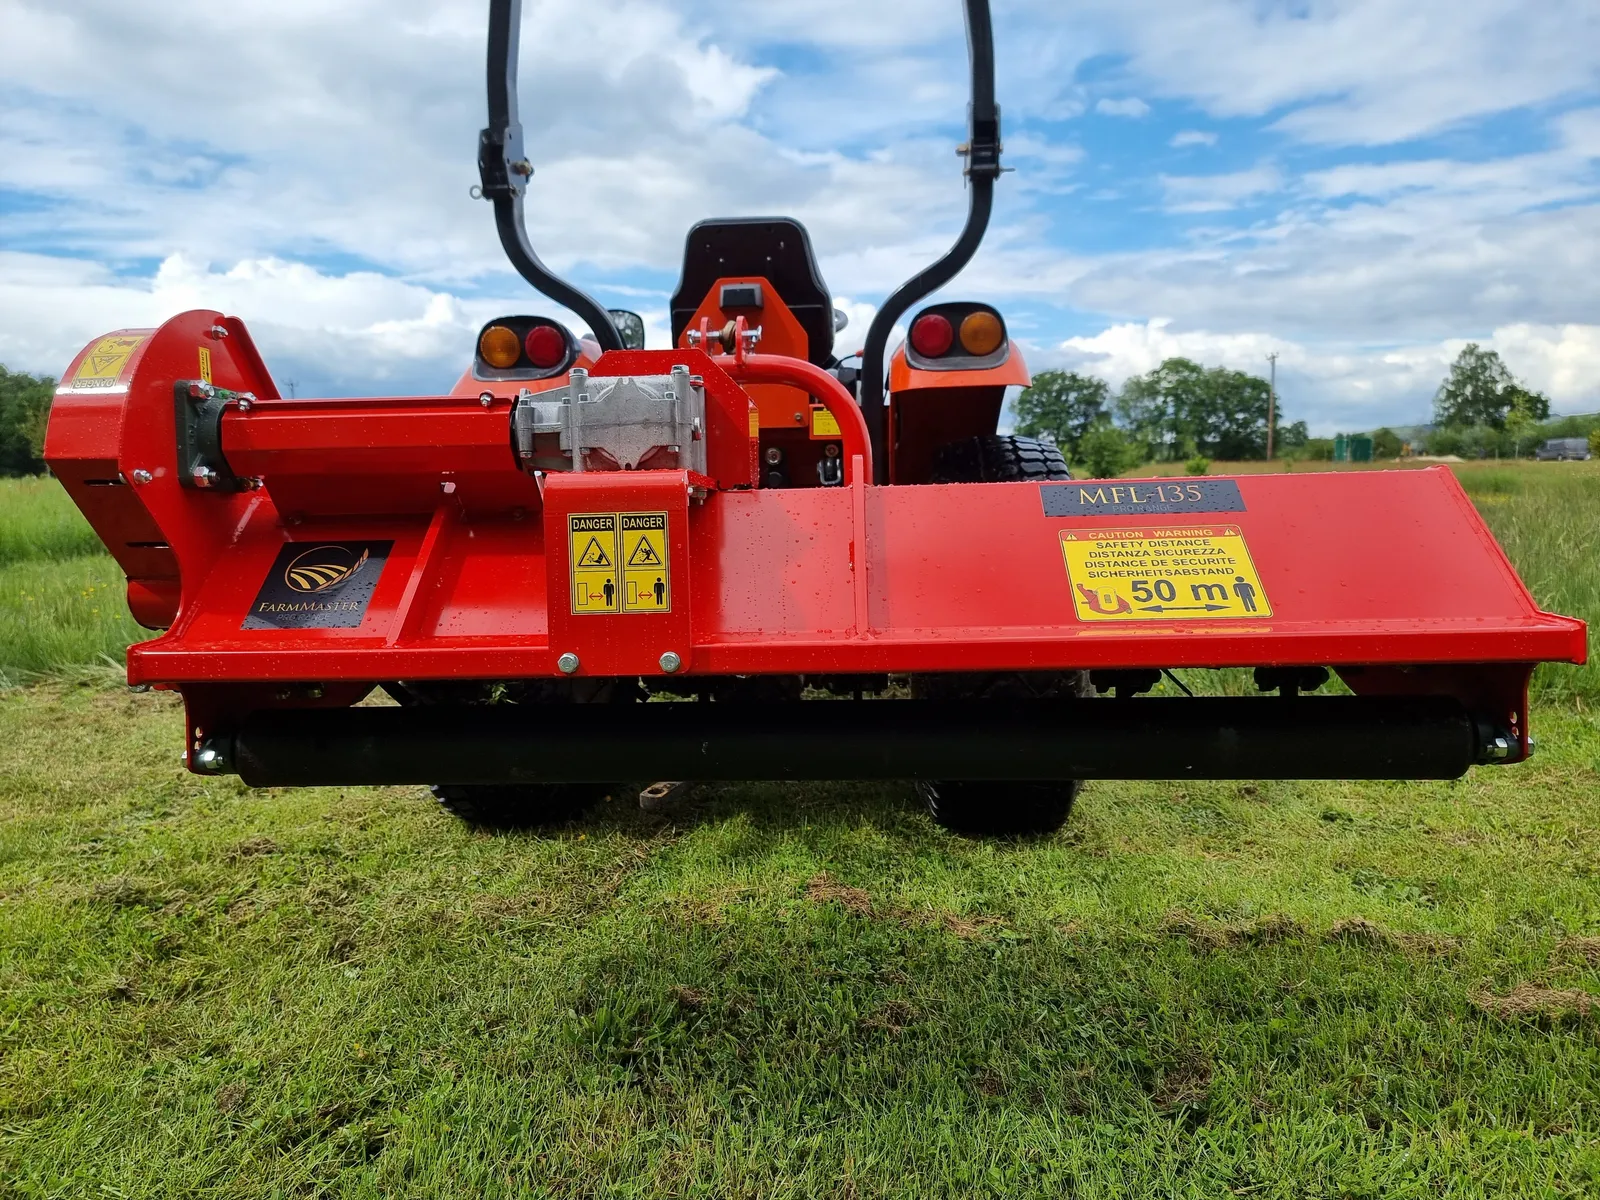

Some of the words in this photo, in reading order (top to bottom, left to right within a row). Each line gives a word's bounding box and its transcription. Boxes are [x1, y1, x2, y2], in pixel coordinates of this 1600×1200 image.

[75, 379, 114, 388] DANGER
[1079, 484, 1202, 504] MFL-135
[573, 519, 613, 530] DANGER
[623, 517, 663, 528] DANGER
[1088, 531, 1143, 540] CAUTION
[1153, 529, 1213, 537] WARNING
[1096, 541, 1143, 549] SAFETY
[1148, 539, 1211, 548] DISTANCE
[1089, 549, 1151, 558] DISTANZA
[1154, 547, 1226, 557] SICUREZZA
[1085, 560, 1148, 569] DISTANCE
[1151, 559, 1168, 567] DE
[1172, 557, 1237, 566] SECURITE
[1088, 567, 1235, 579] SICHERHEITSABSTAND
[1131, 579, 1177, 602] 50
[1190, 582, 1228, 601] m
